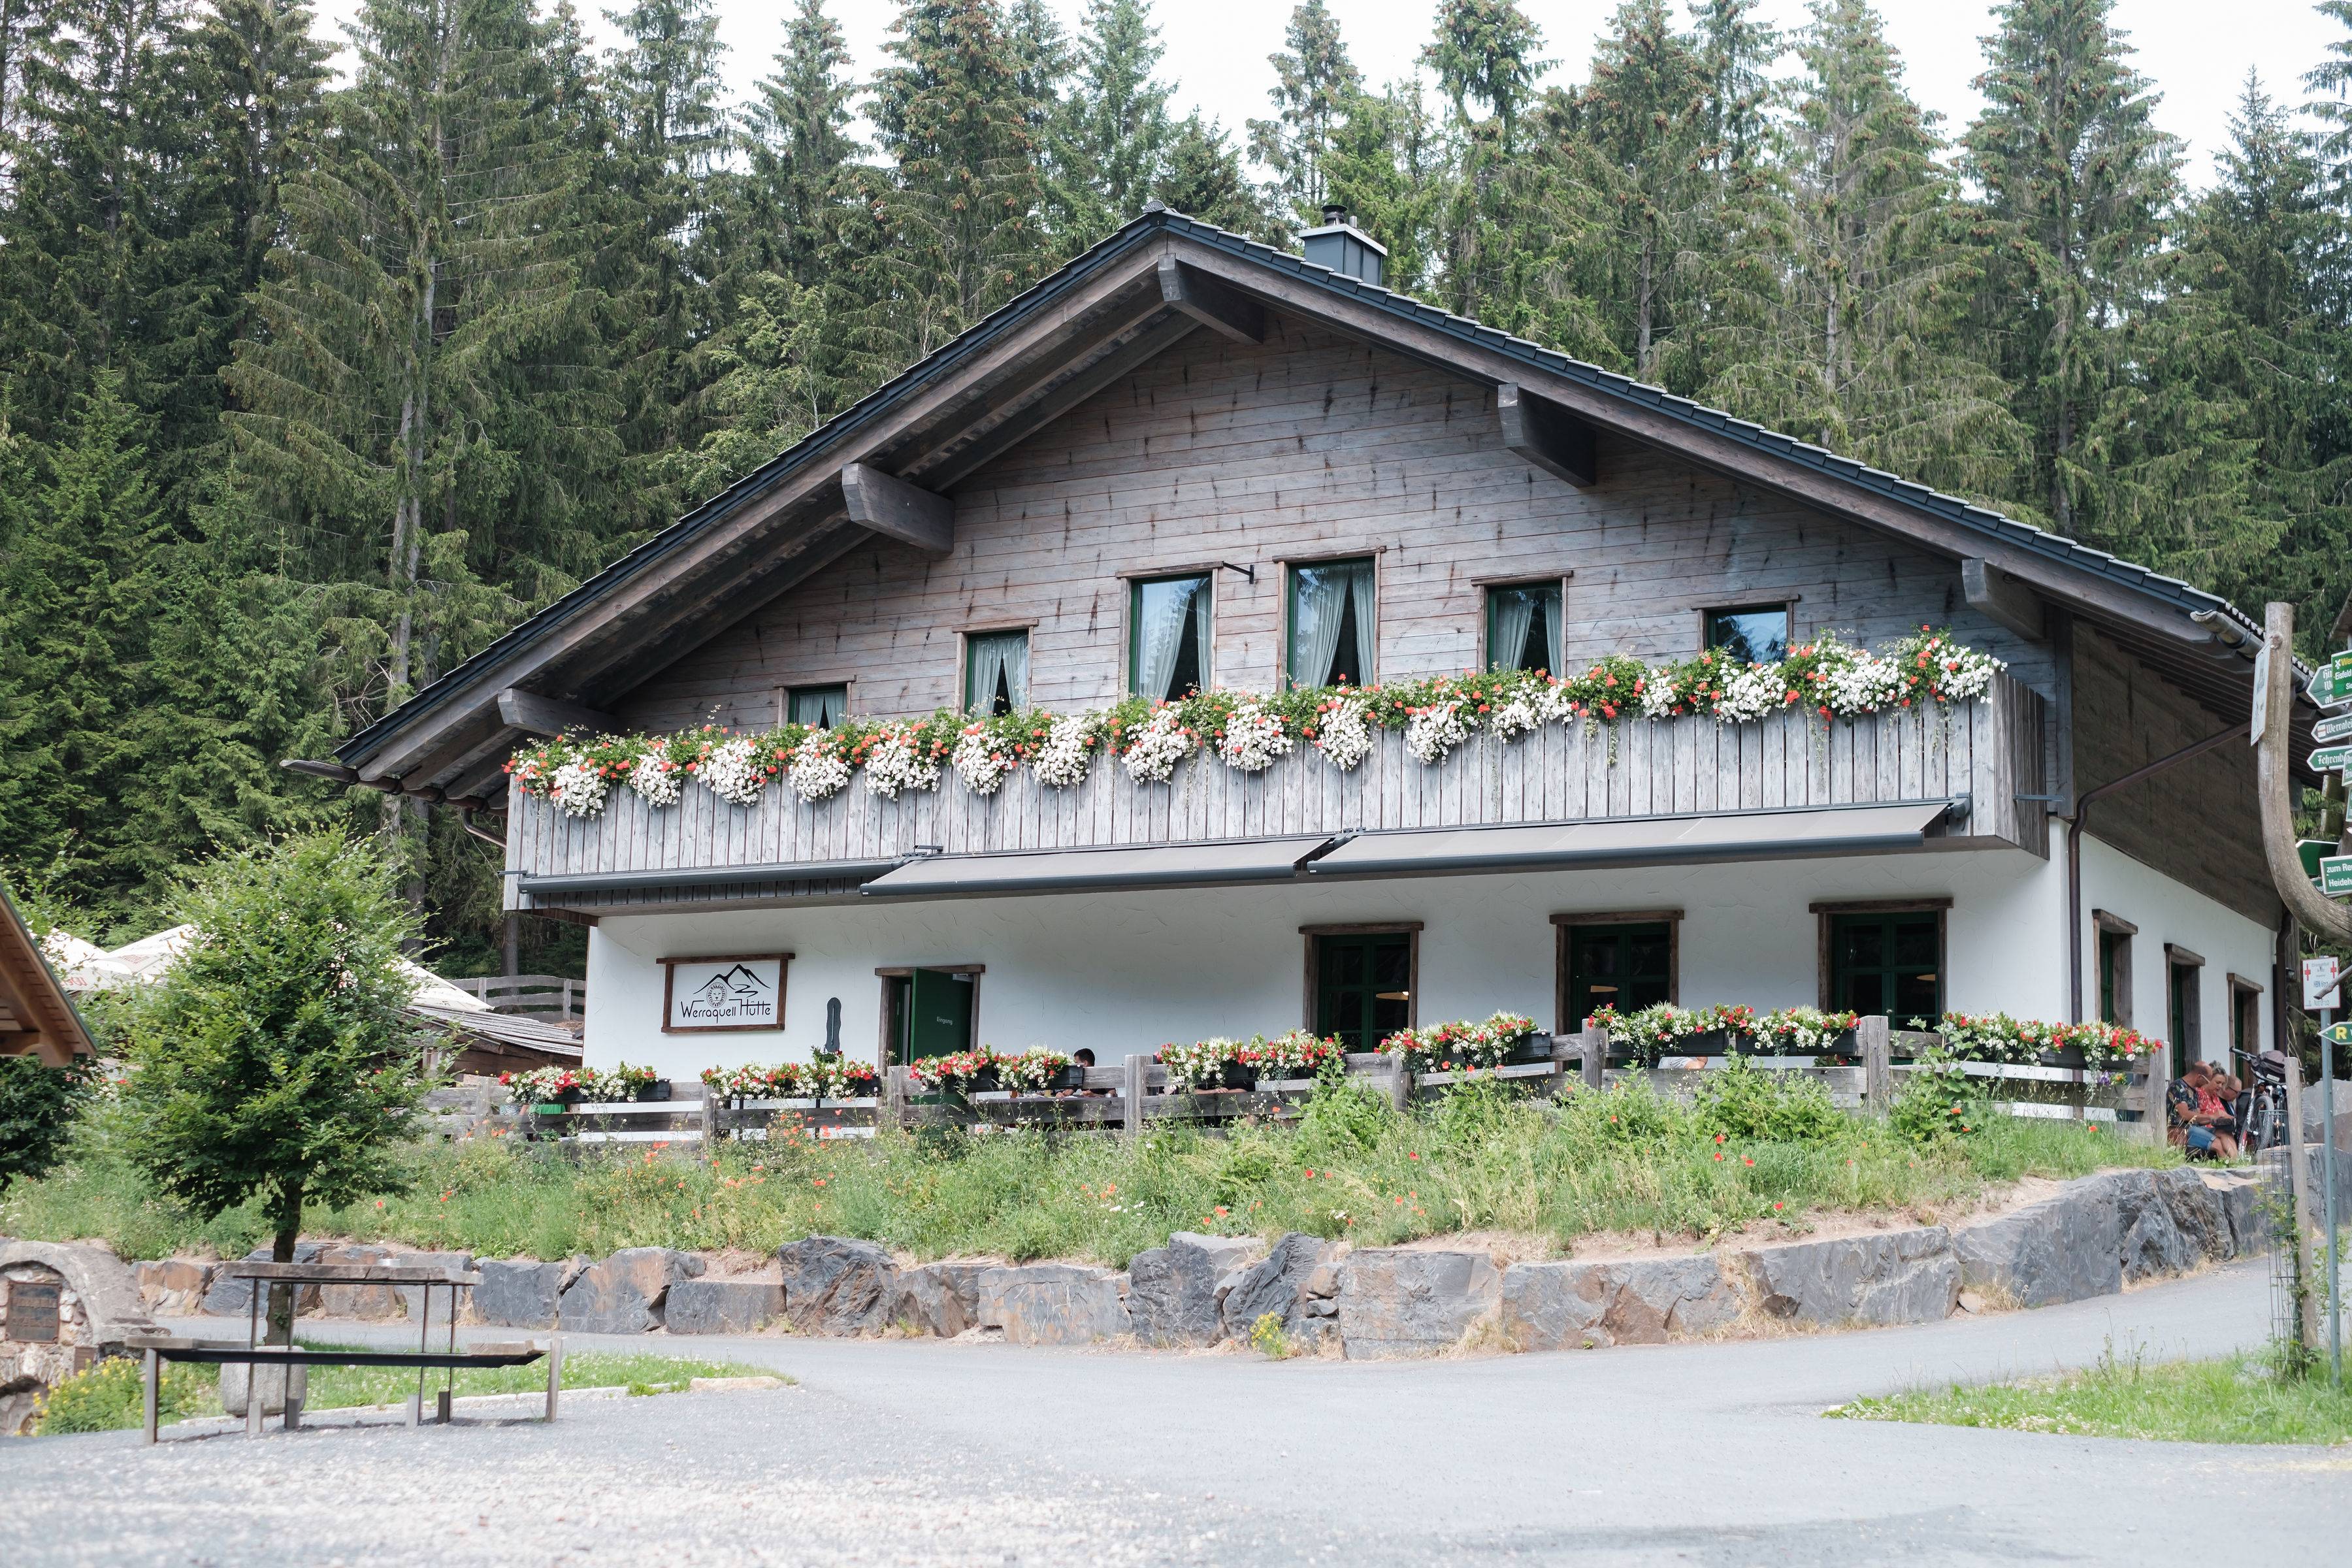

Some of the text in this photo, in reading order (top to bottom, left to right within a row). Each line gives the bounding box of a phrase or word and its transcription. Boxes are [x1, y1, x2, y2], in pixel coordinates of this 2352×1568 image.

[2335, 669, 2351, 680] Eisfeld
[681, 998, 771, 1024] Werraquell Hütte
[936, 1016, 953, 1026] Eingang
[2336, 1026, 2347, 1040] R
